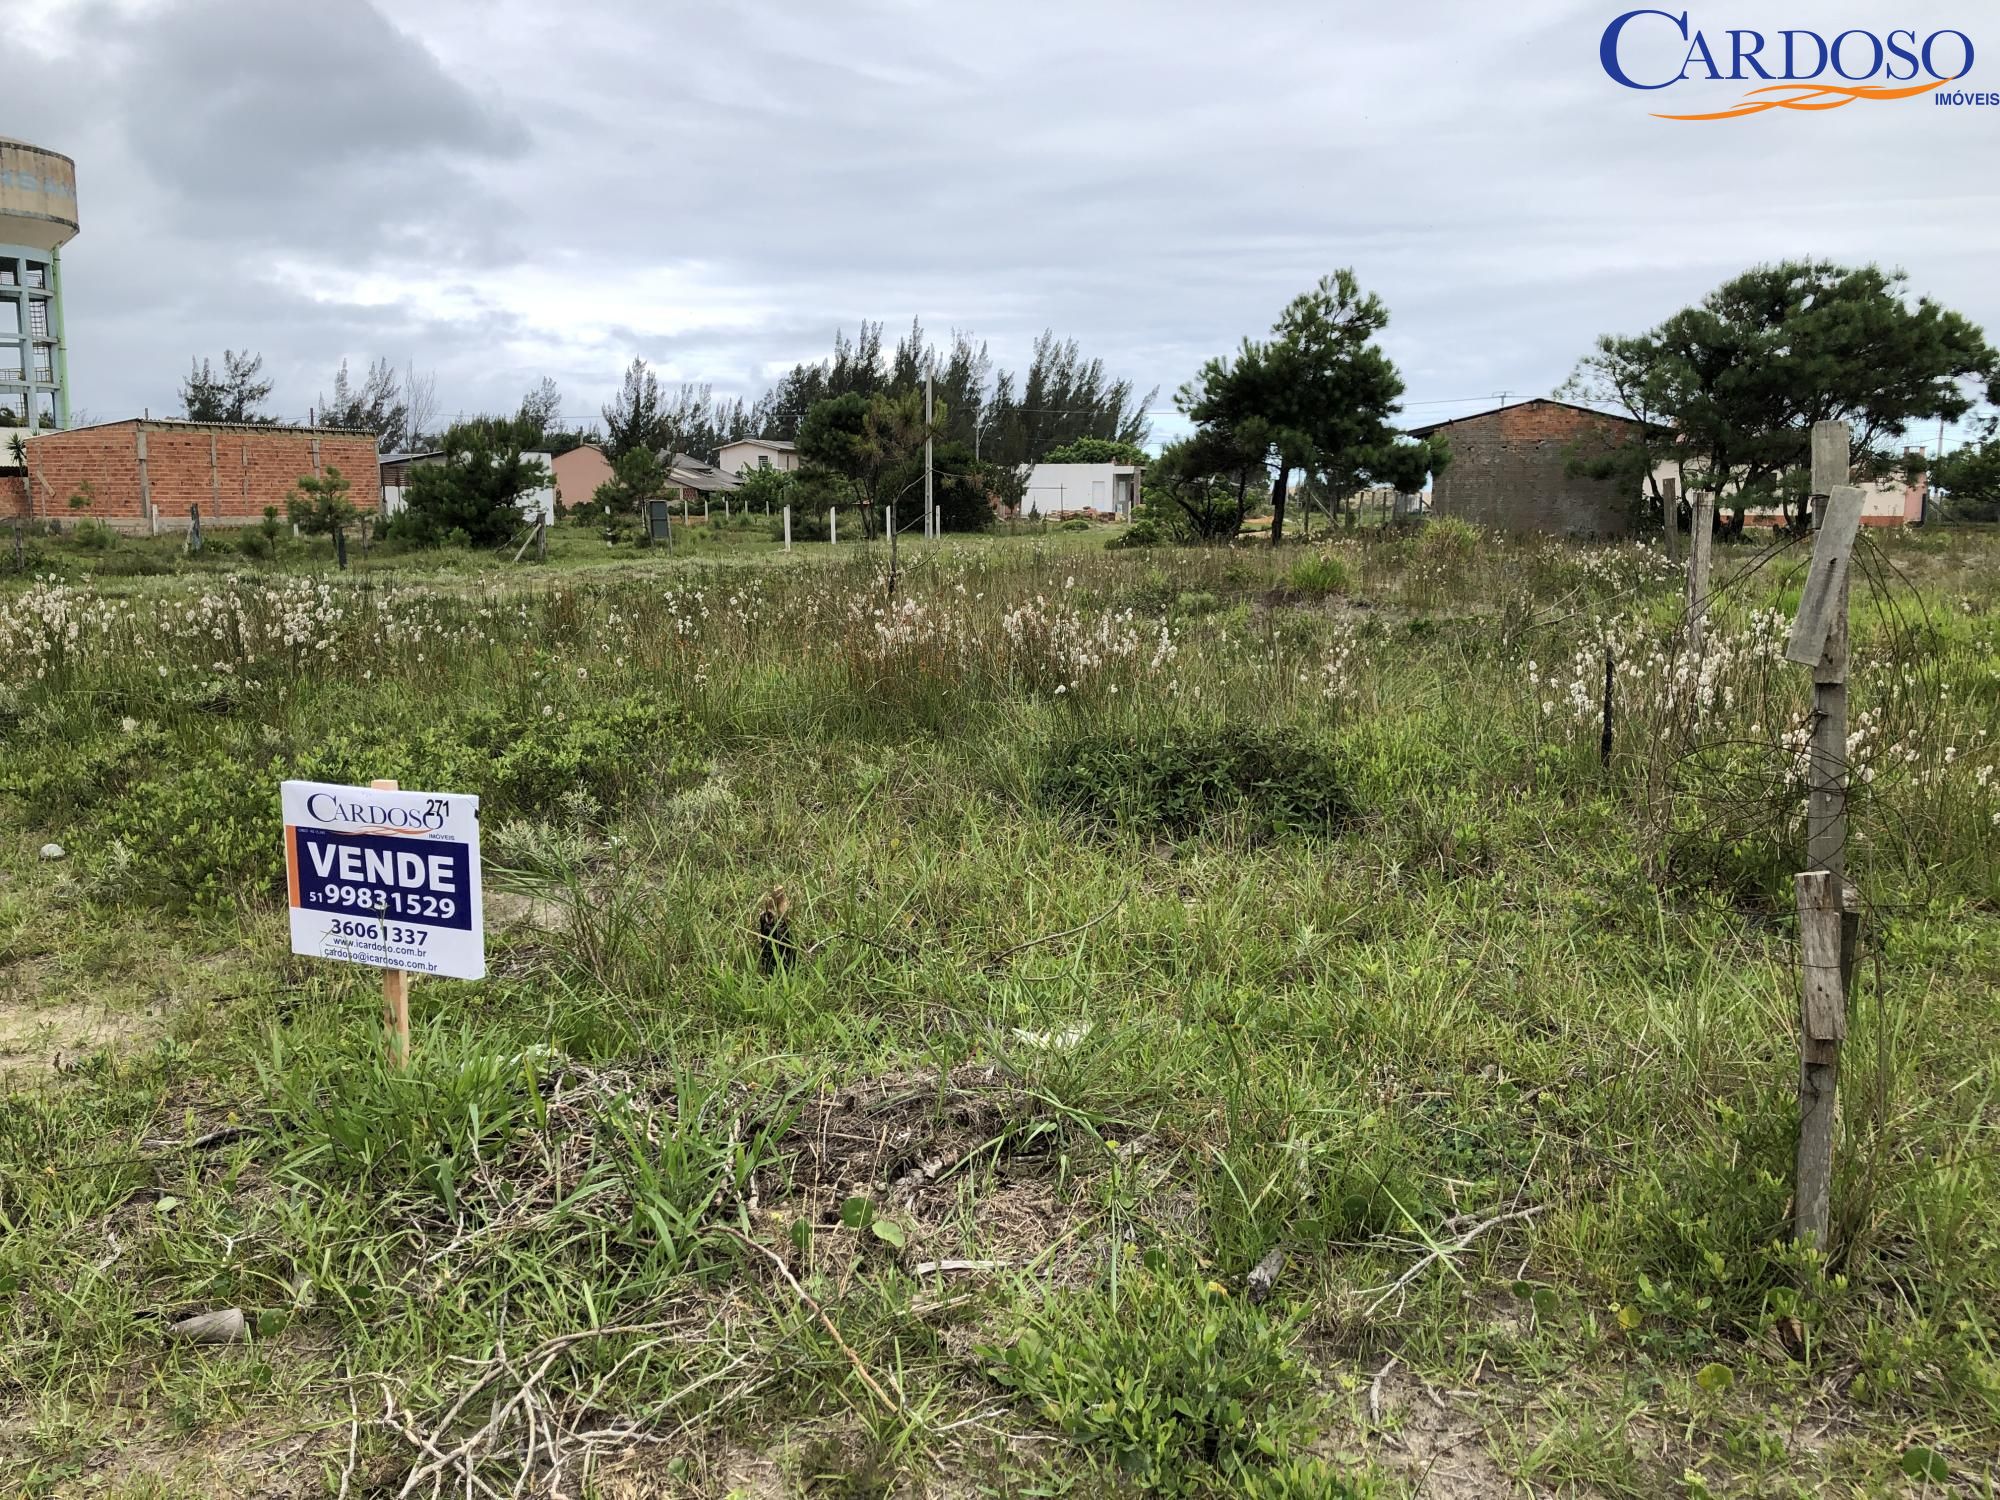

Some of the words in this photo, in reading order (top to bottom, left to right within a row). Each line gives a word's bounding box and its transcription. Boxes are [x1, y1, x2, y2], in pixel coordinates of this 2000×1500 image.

[307, 793, 444, 830] CARDOSO
[426, 799, 450, 818] 271
[428, 833, 455, 841] IMÓVEIS
[307, 842, 456, 893] VENDE
[309, 891, 323, 903] 51
[324, 884, 456, 919] 99831529
[331, 919, 428, 946] 36061337
[333, 938, 427, 957] www.icardoso.com.br
